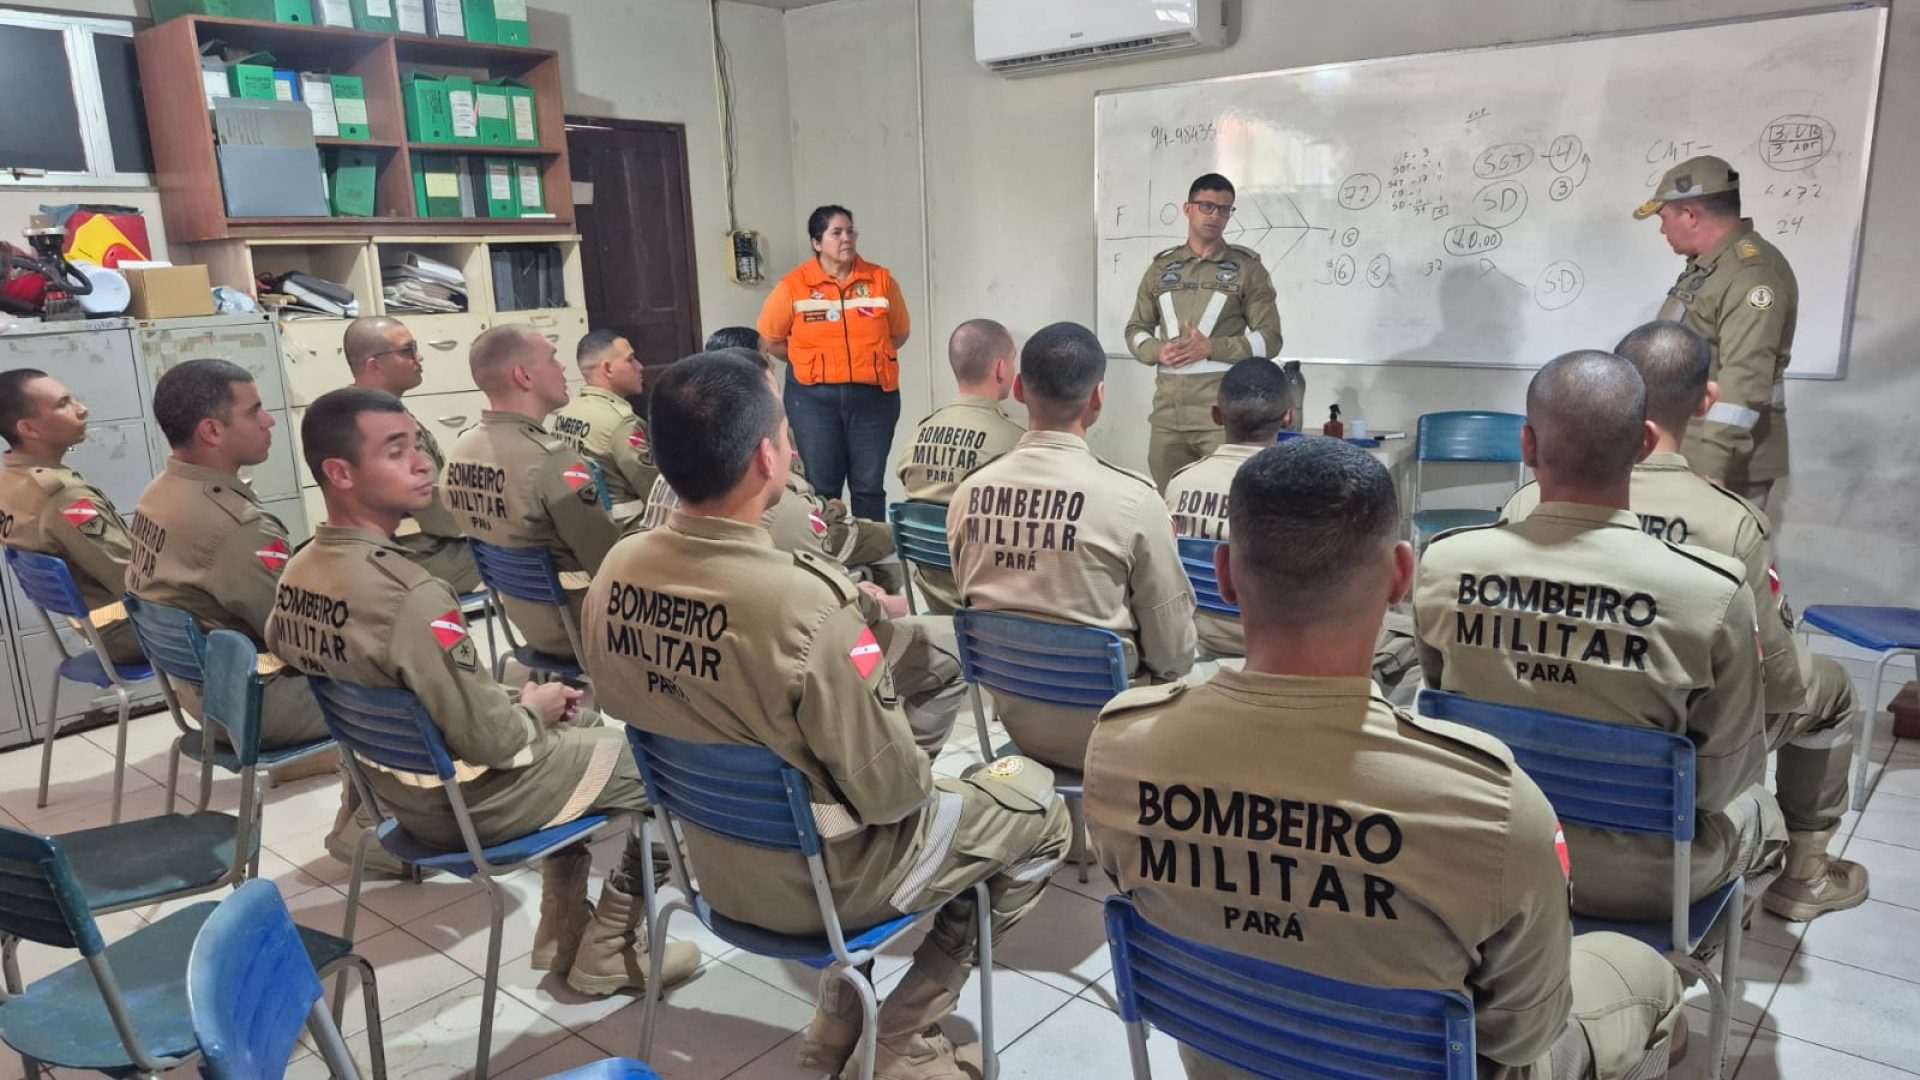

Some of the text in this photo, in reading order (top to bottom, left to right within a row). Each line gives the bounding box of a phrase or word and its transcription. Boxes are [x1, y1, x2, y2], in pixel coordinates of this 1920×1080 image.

[917, 425, 987, 449] BOMBEIRO
[912, 445, 978, 470] MILITAR
[926, 466, 954, 483] PARÁ
[447, 462, 505, 494] BOMBEIRO
[447, 489, 508, 519] MILITAR
[968, 485, 1086, 521] BOMBEIRO
[965, 518, 1078, 552] MILITAR
[994, 551, 1036, 571] PARÁ
[607, 581, 728, 643] BOMBEIRO
[1457, 573, 1657, 627] BOMBEIRO
[607, 622, 722, 682] MILITAR
[1456, 612, 1649, 671] MILITAR
[1516, 661, 1577, 685] PARÁ
[1138, 781, 1402, 865] BOMBEIRO
[1138, 835, 1399, 920] MILITAR
[1223, 906, 1305, 942] PARÁ
